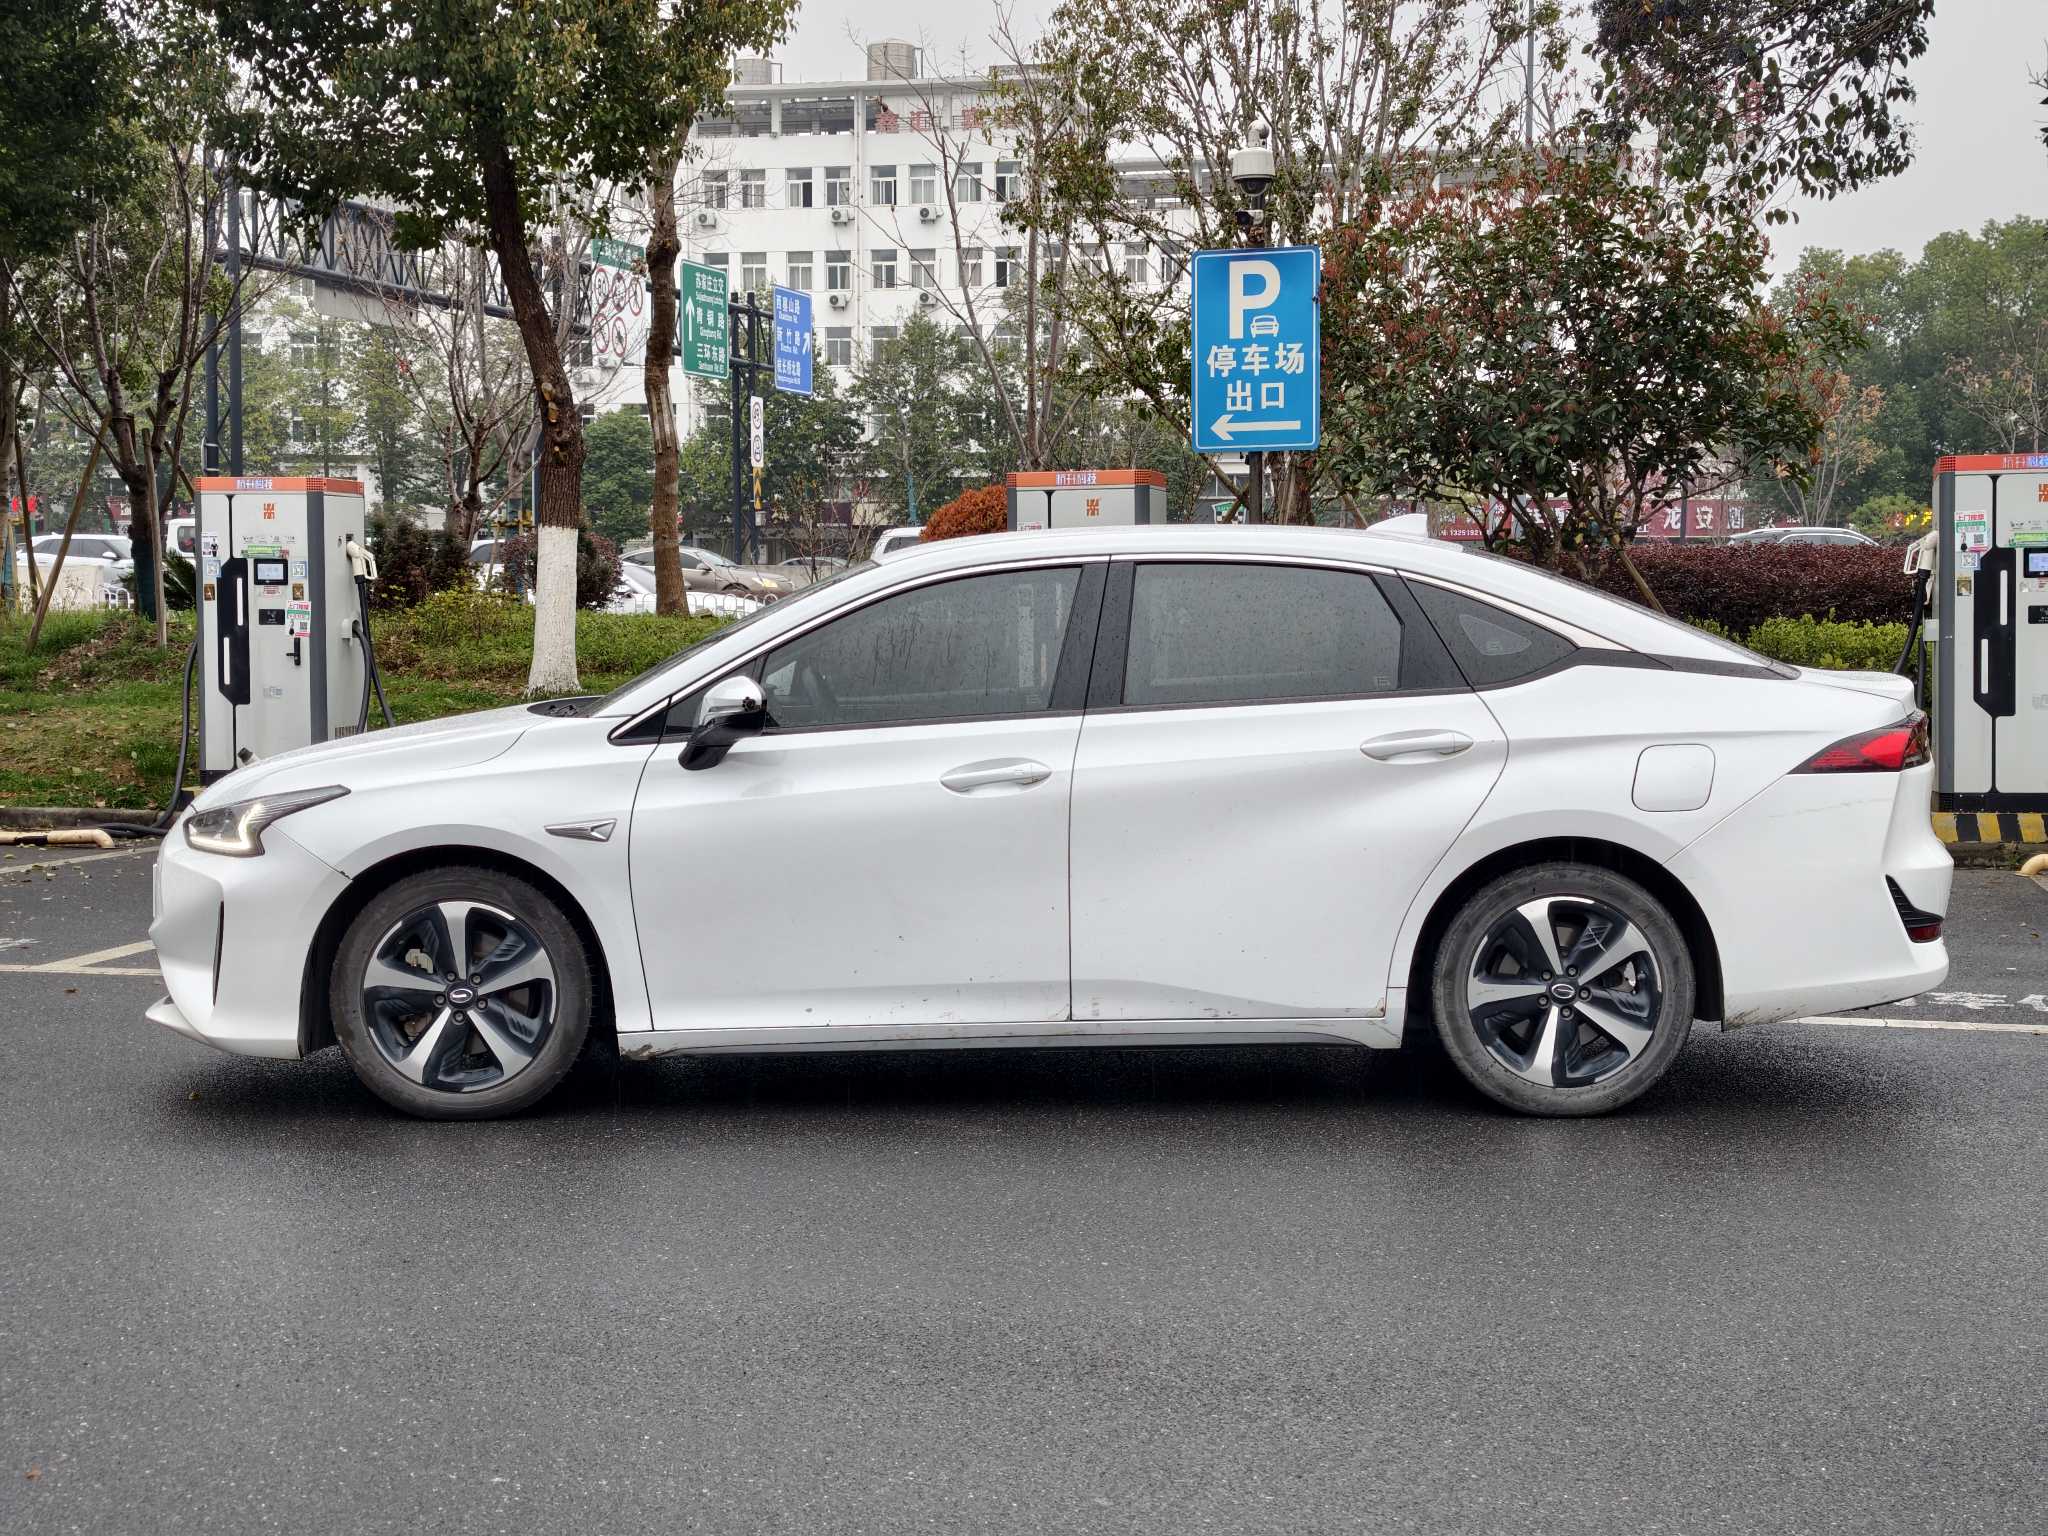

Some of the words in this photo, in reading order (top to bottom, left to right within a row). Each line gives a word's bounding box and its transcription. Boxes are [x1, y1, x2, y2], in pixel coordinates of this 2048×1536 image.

[1229, 260, 1281, 339] P
[1206, 342, 1305, 378] 停车场
[1226, 380, 1285, 411] 出口
